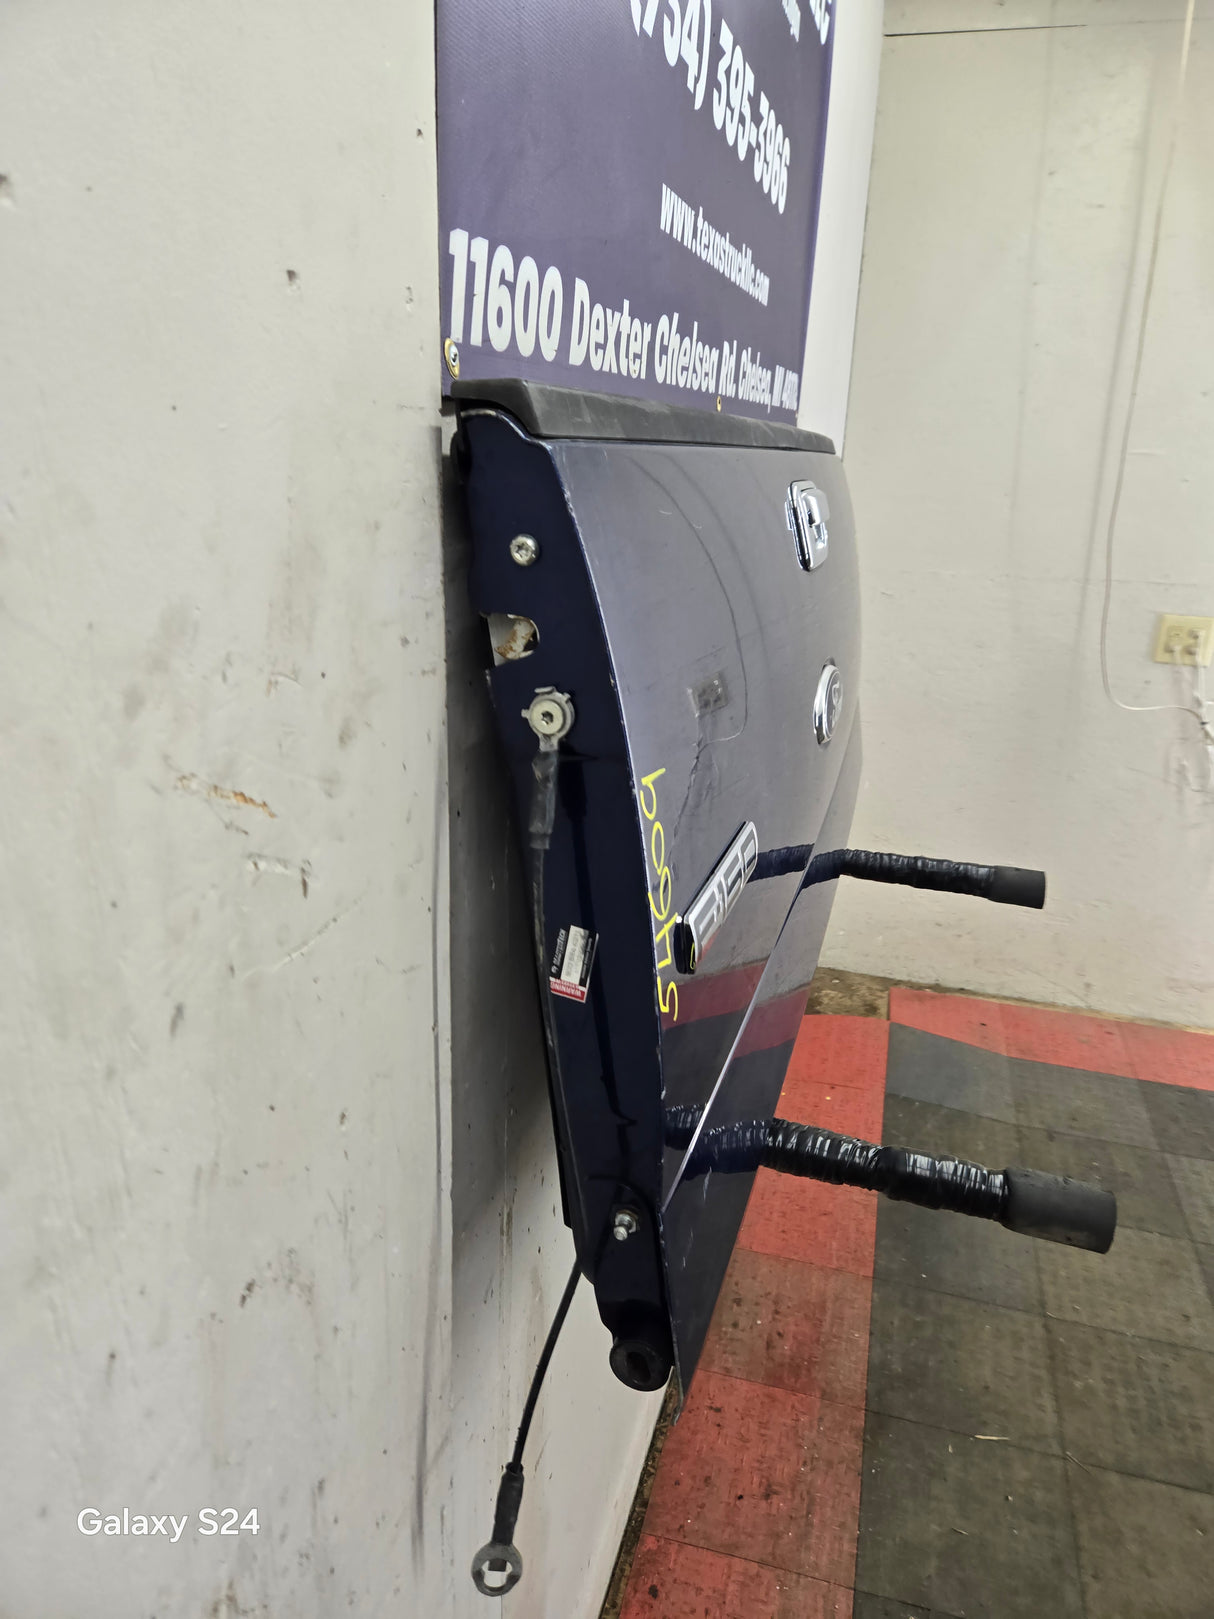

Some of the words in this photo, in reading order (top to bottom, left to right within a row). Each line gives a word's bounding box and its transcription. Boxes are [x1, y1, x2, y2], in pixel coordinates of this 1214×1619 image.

[713, 18, 791, 215] 395-3966
[449, 228, 563, 362] 11600
[569, 277, 652, 379] Dexter
[654, 312, 720, 393] Chelsea
[718, 340, 738, 398] Rd.
[640, 768, 679, 1021] 54609
